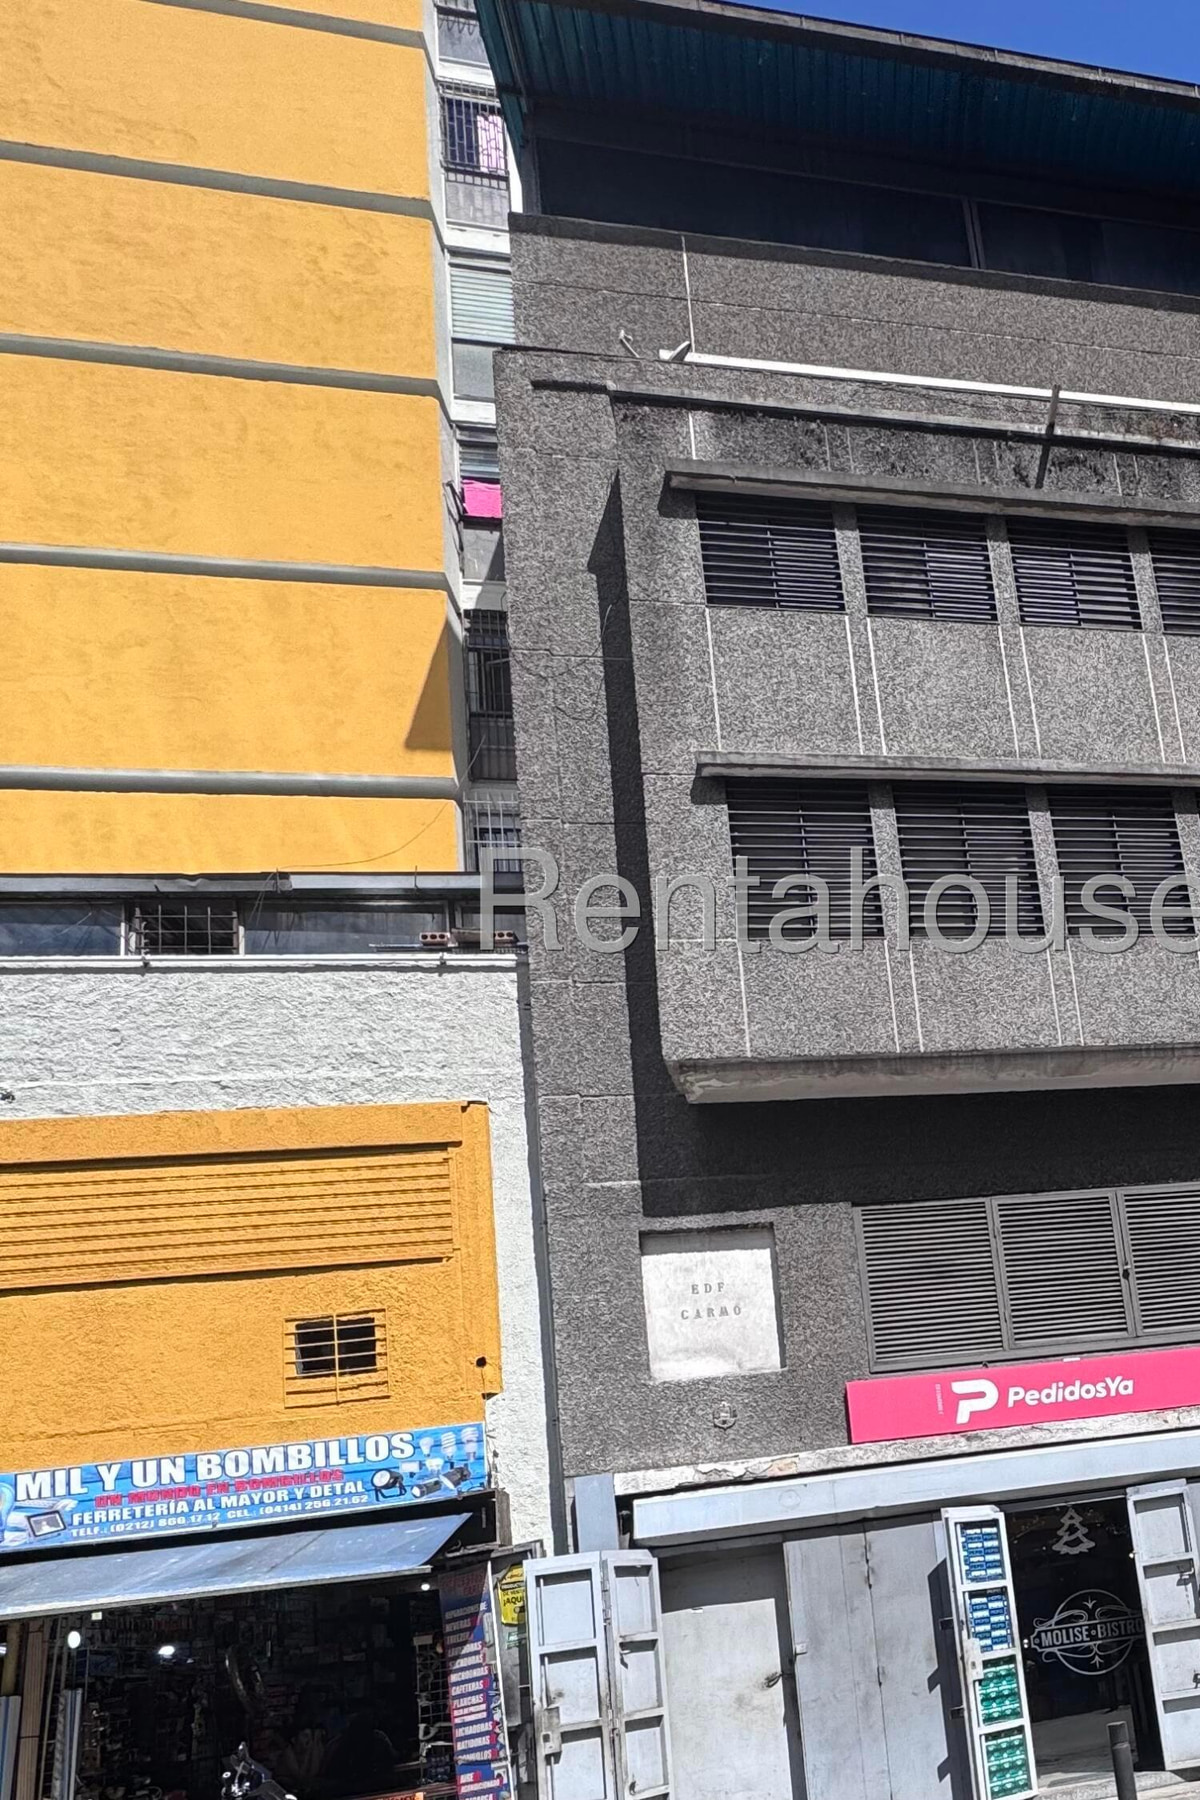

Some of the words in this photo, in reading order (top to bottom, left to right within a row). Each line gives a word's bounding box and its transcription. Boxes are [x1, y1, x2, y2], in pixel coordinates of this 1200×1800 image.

[691, 1282, 725, 1295] EDF
[1007, 1375, 1134, 1408] PedidosYa
[15, 1467, 88, 1502] MIL
[95, 1463, 122, 1491] Y
[131, 1456, 186, 1488] UN
[196, 1433, 415, 1481] BOMBILLOS
[72, 1501, 190, 1526] FERRETERÍA
[193, 1499, 216, 1513] AL
[220, 1489, 289, 1508] MAYOR
[293, 1487, 305, 1500] Y
[311, 1480, 365, 1498] DETAL
[128, 1485, 200, 1504] MUNDO
[235, 1468, 344, 1492] BOMBILLOS
[1041, 1626, 1090, 1647] MOLISE
[1097, 1620, 1144, 1638] BISTRO
